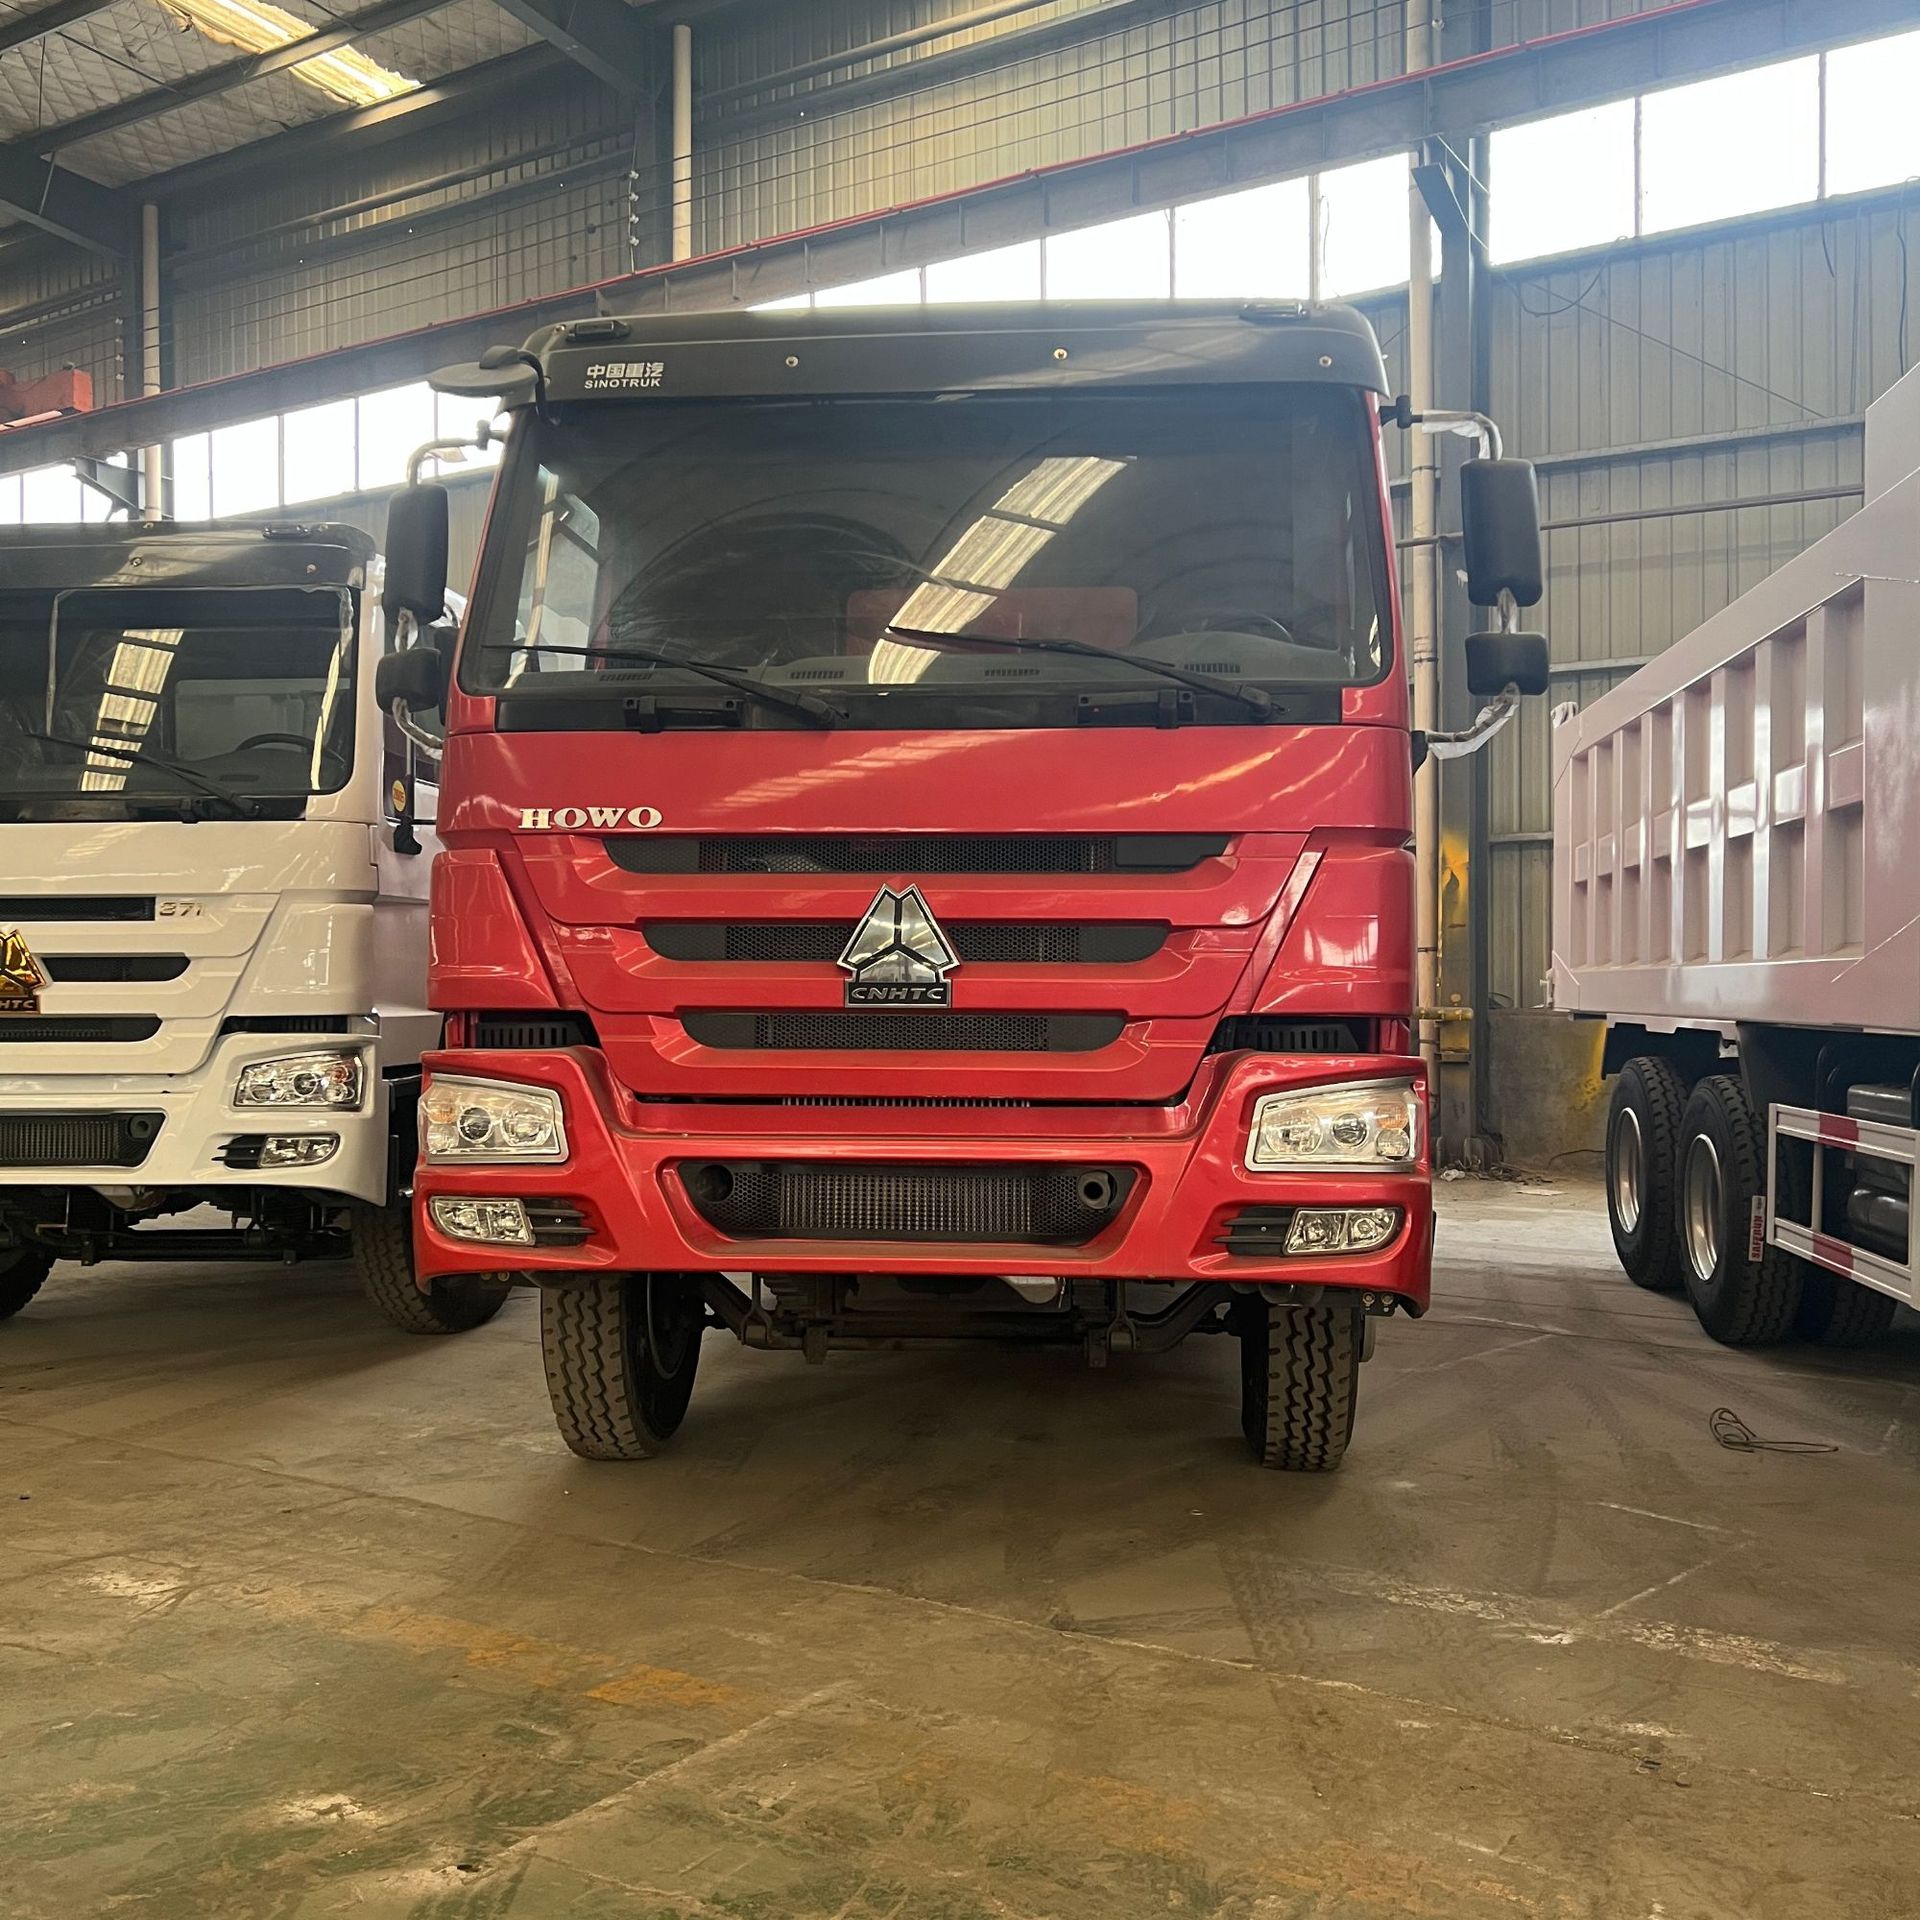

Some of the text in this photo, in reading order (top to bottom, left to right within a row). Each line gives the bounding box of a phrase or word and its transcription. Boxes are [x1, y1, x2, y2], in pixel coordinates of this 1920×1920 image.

[584, 378, 661, 389] SINOTRUK
[517, 806, 664, 829] HOWO
[851, 987, 944, 1000] CNHTC
